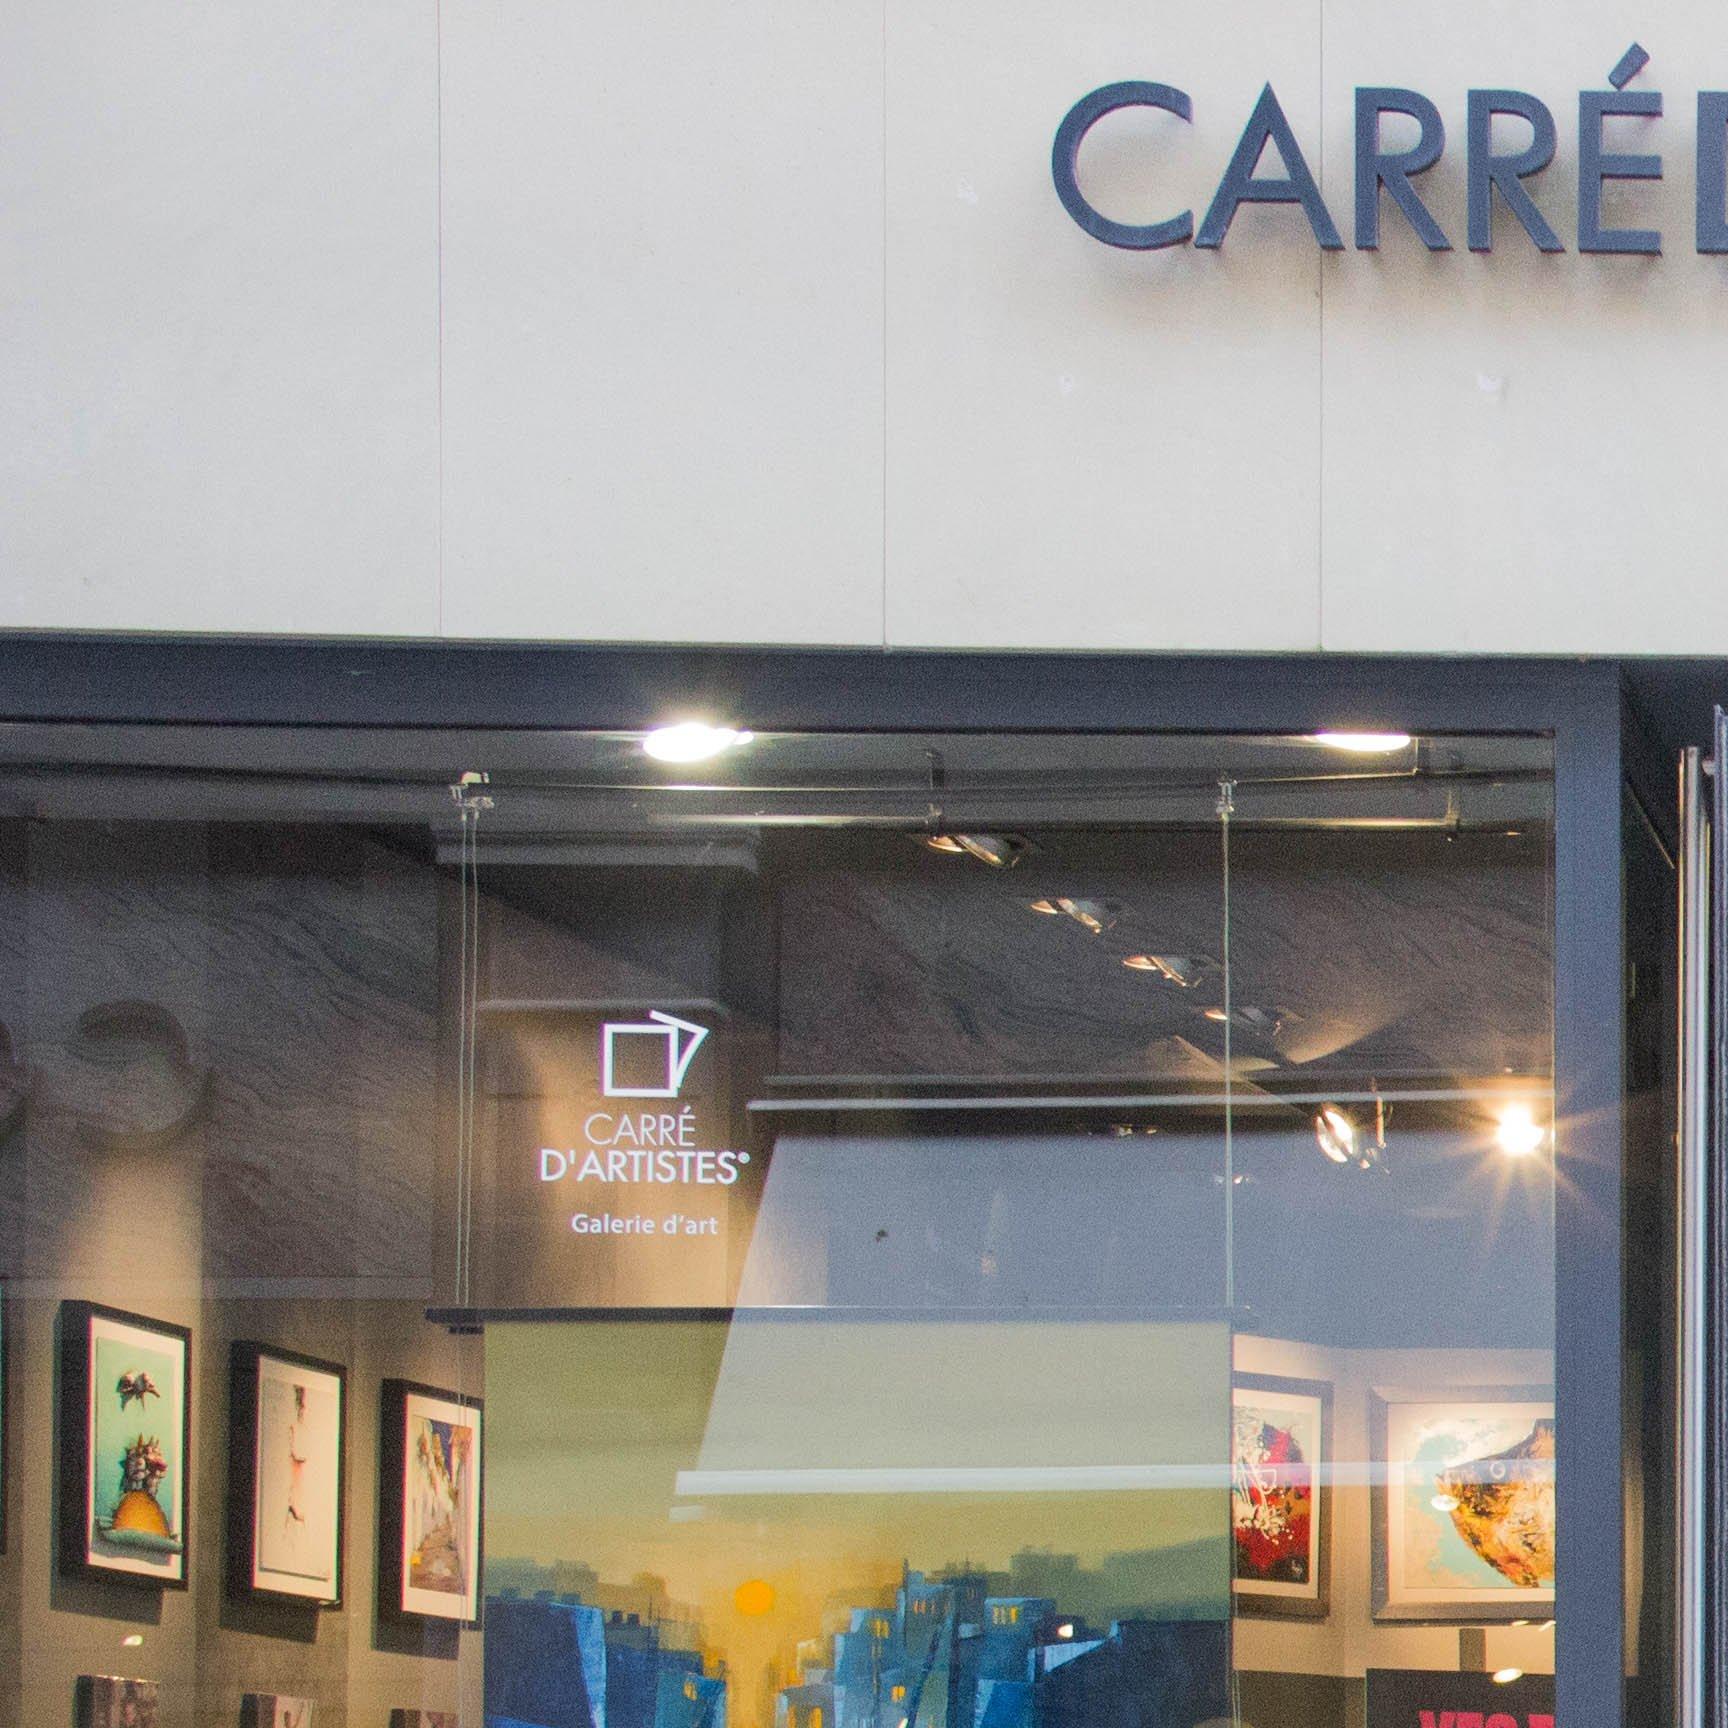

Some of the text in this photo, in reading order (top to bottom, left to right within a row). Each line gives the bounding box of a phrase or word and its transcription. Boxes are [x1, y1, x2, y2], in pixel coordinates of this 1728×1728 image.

[583, 1106, 696, 1147] CARRÉ
[571, 1213, 718, 1235] Galerie d'art
